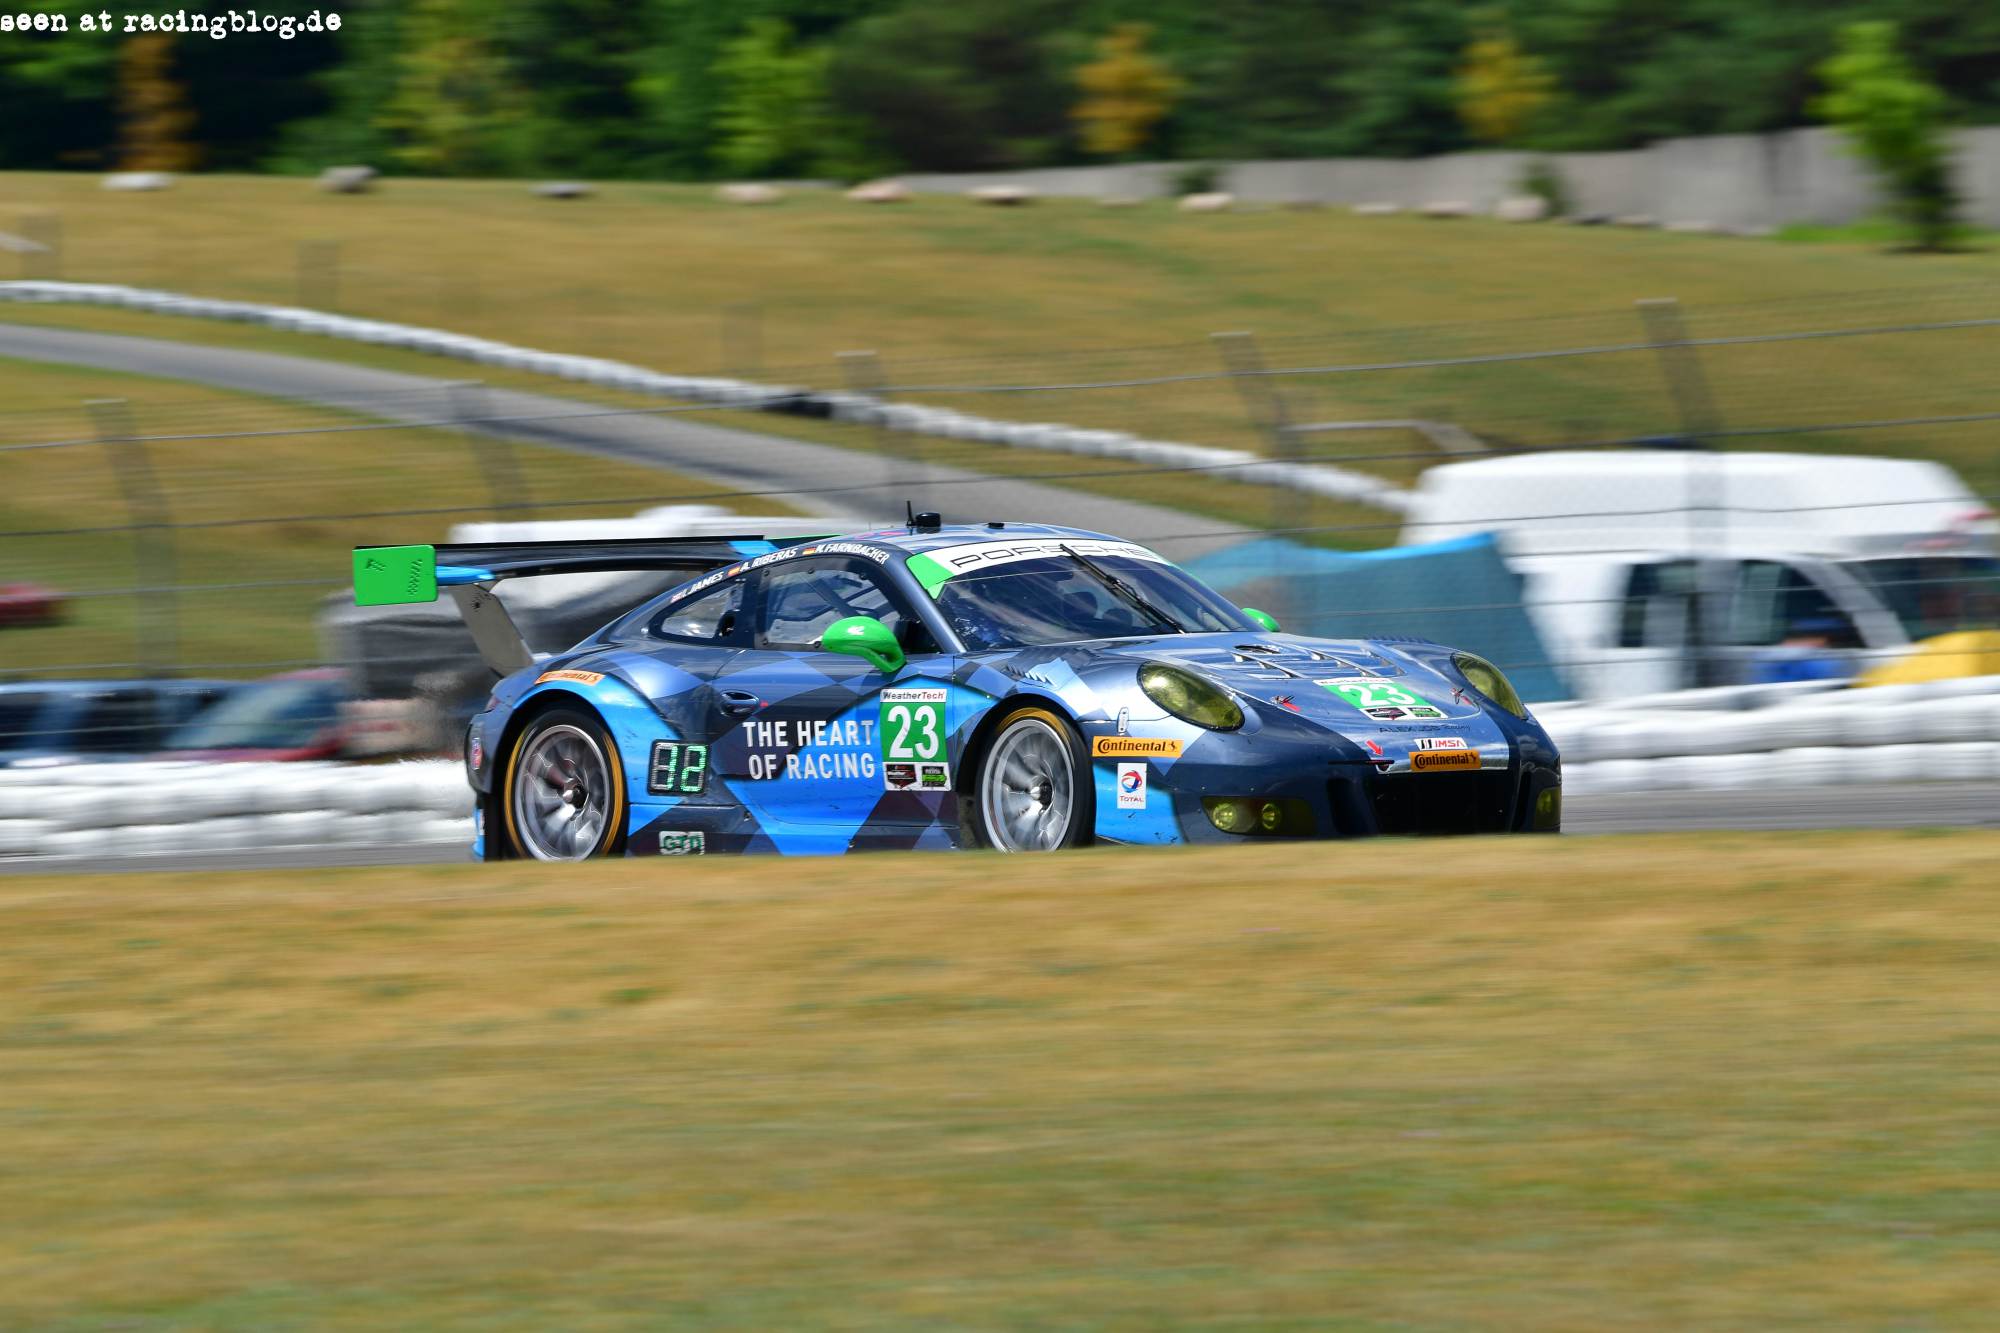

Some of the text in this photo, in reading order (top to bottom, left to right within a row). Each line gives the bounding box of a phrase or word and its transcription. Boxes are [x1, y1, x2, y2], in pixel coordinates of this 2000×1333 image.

[883, 691, 945, 700] WeatherTech
[1339, 684, 1416, 706] 23
[742, 720, 874, 747] THE HEART
[887, 705, 939, 759] 23
[1097, 739, 1166, 754] Continental
[1435, 739, 1464, 748] IMSA
[748, 754, 777, 779] OF
[786, 752, 875, 779] RACING
[1414, 752, 1469, 769] Continental
